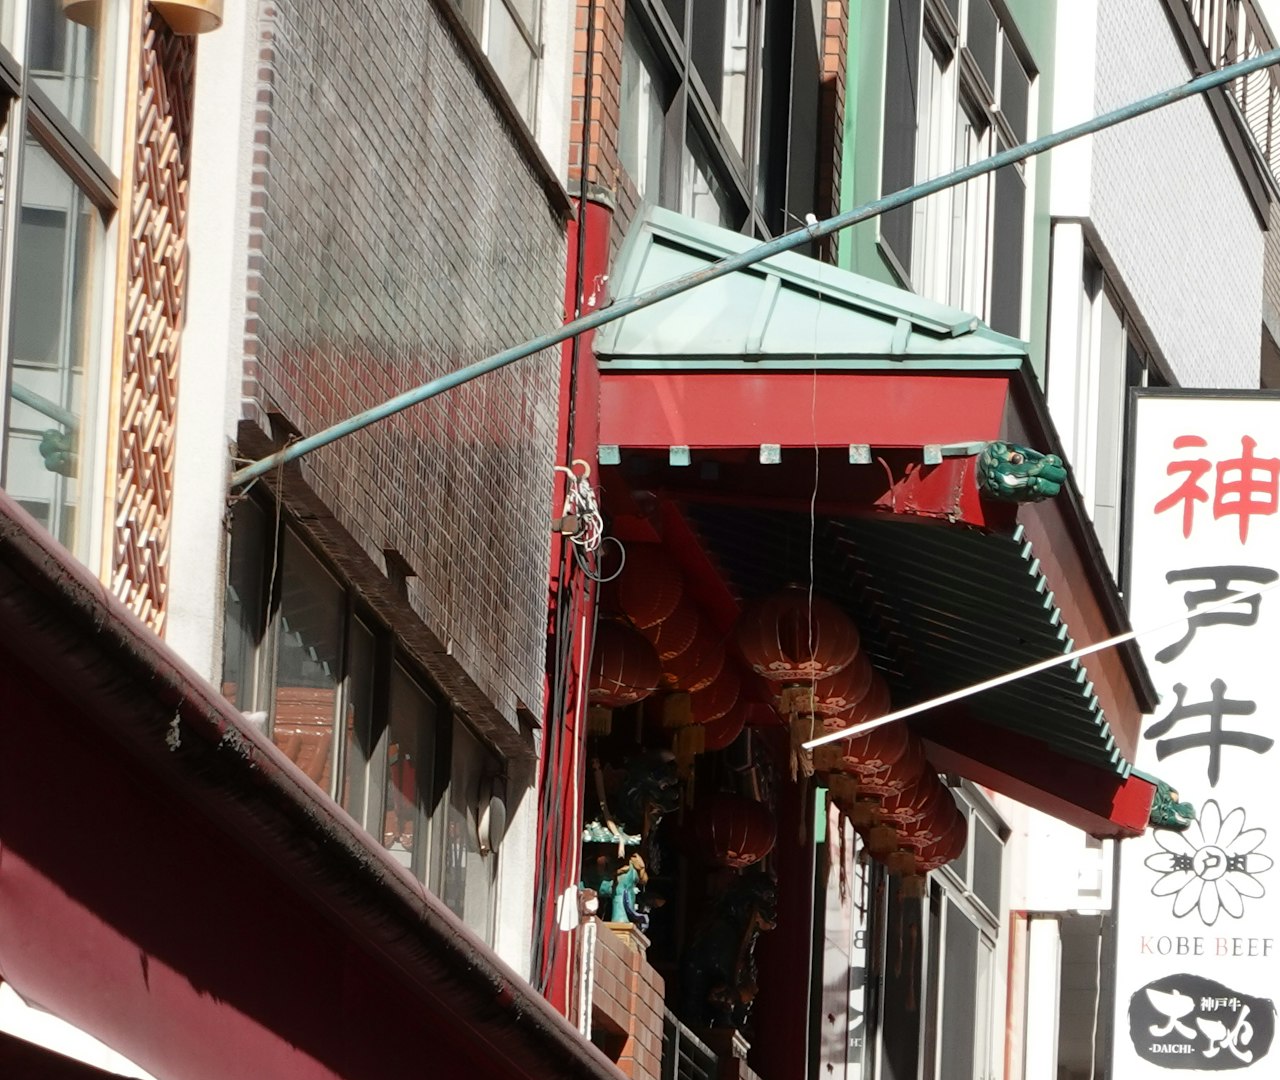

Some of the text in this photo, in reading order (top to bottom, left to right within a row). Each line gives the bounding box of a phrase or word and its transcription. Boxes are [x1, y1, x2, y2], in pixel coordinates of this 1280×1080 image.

[1140, 935, 1275, 957] KOBE BEEF
[1200, 996, 1242, 1012] 神戸牛
